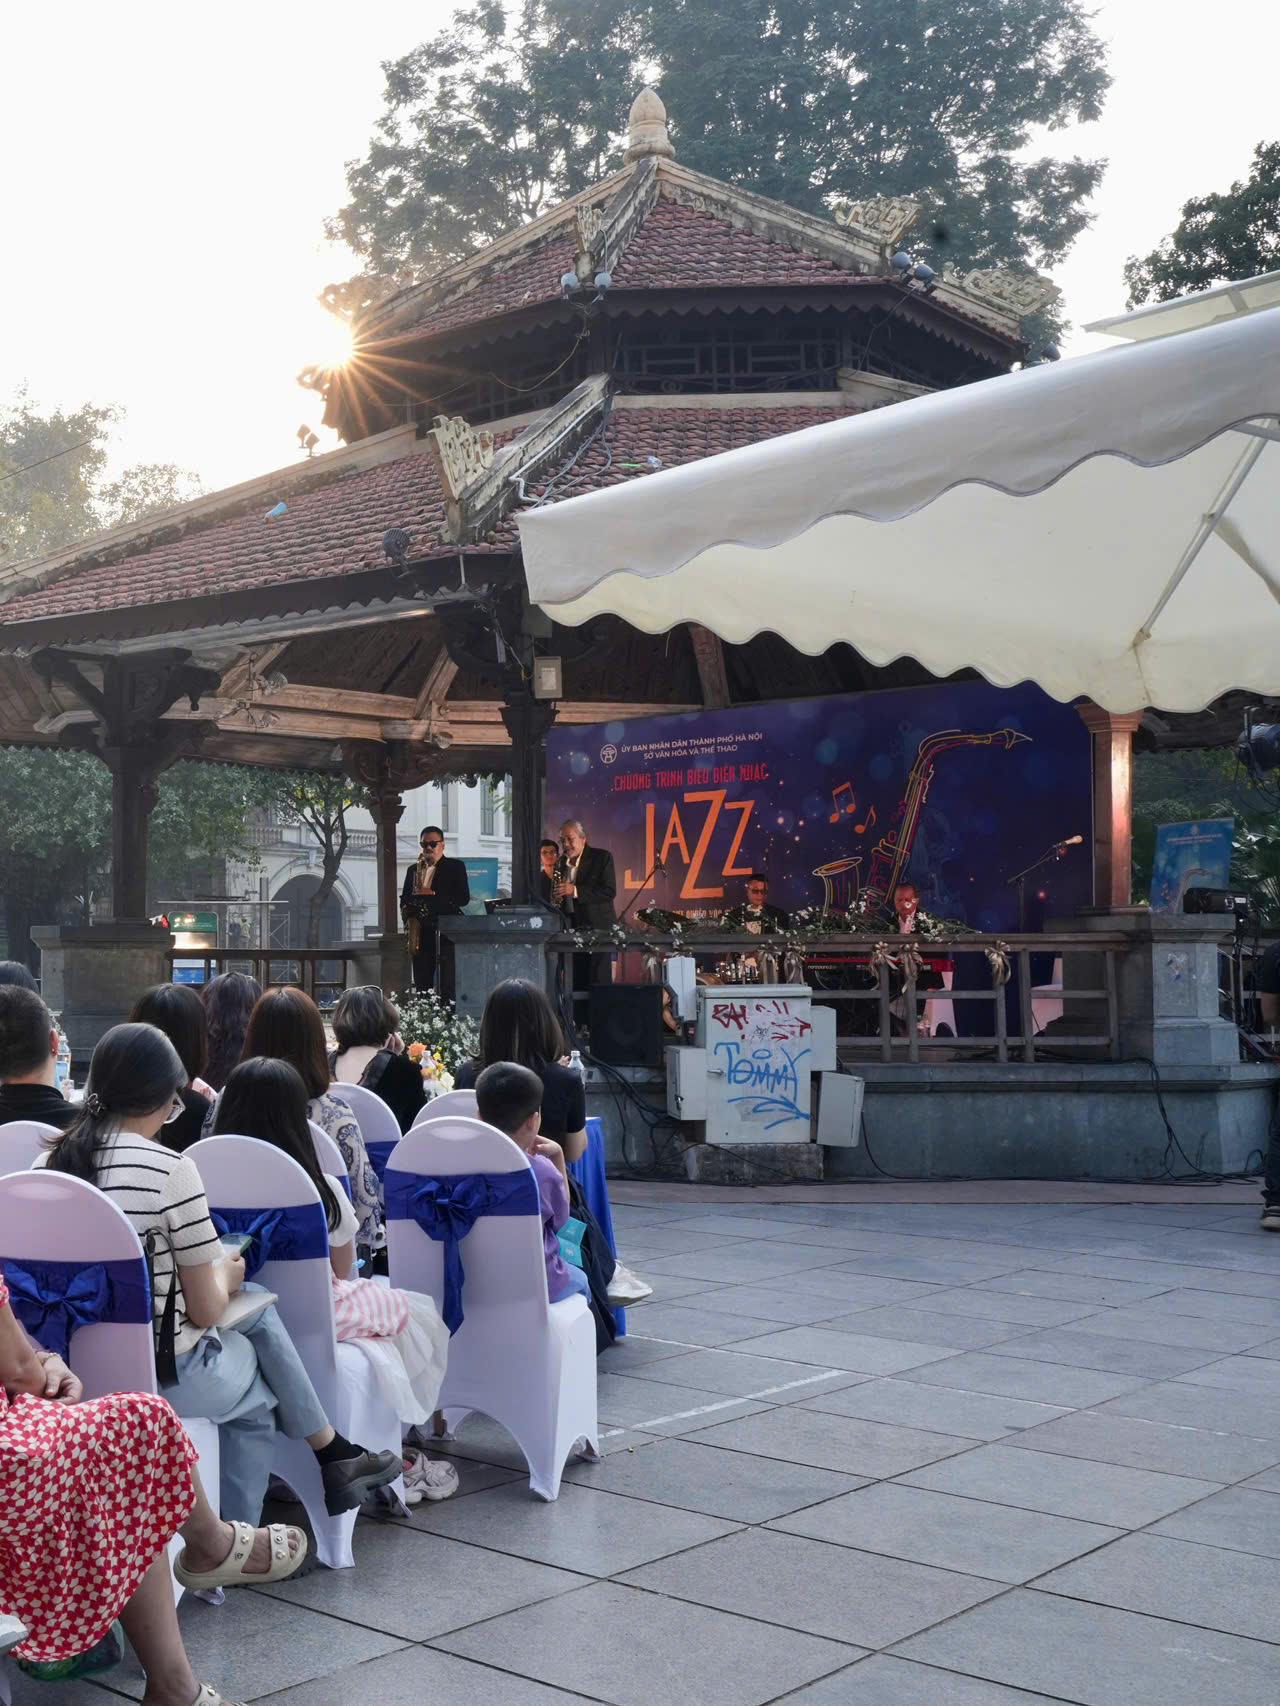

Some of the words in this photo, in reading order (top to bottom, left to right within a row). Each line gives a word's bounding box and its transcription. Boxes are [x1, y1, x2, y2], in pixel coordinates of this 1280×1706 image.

[632, 744, 648, 752] BAN
[689, 737, 715, 747] THÀNH
[735, 733, 747, 742] HÀ
[717, 744, 738, 753] THAO
[624, 789, 756, 899] JAZZ
